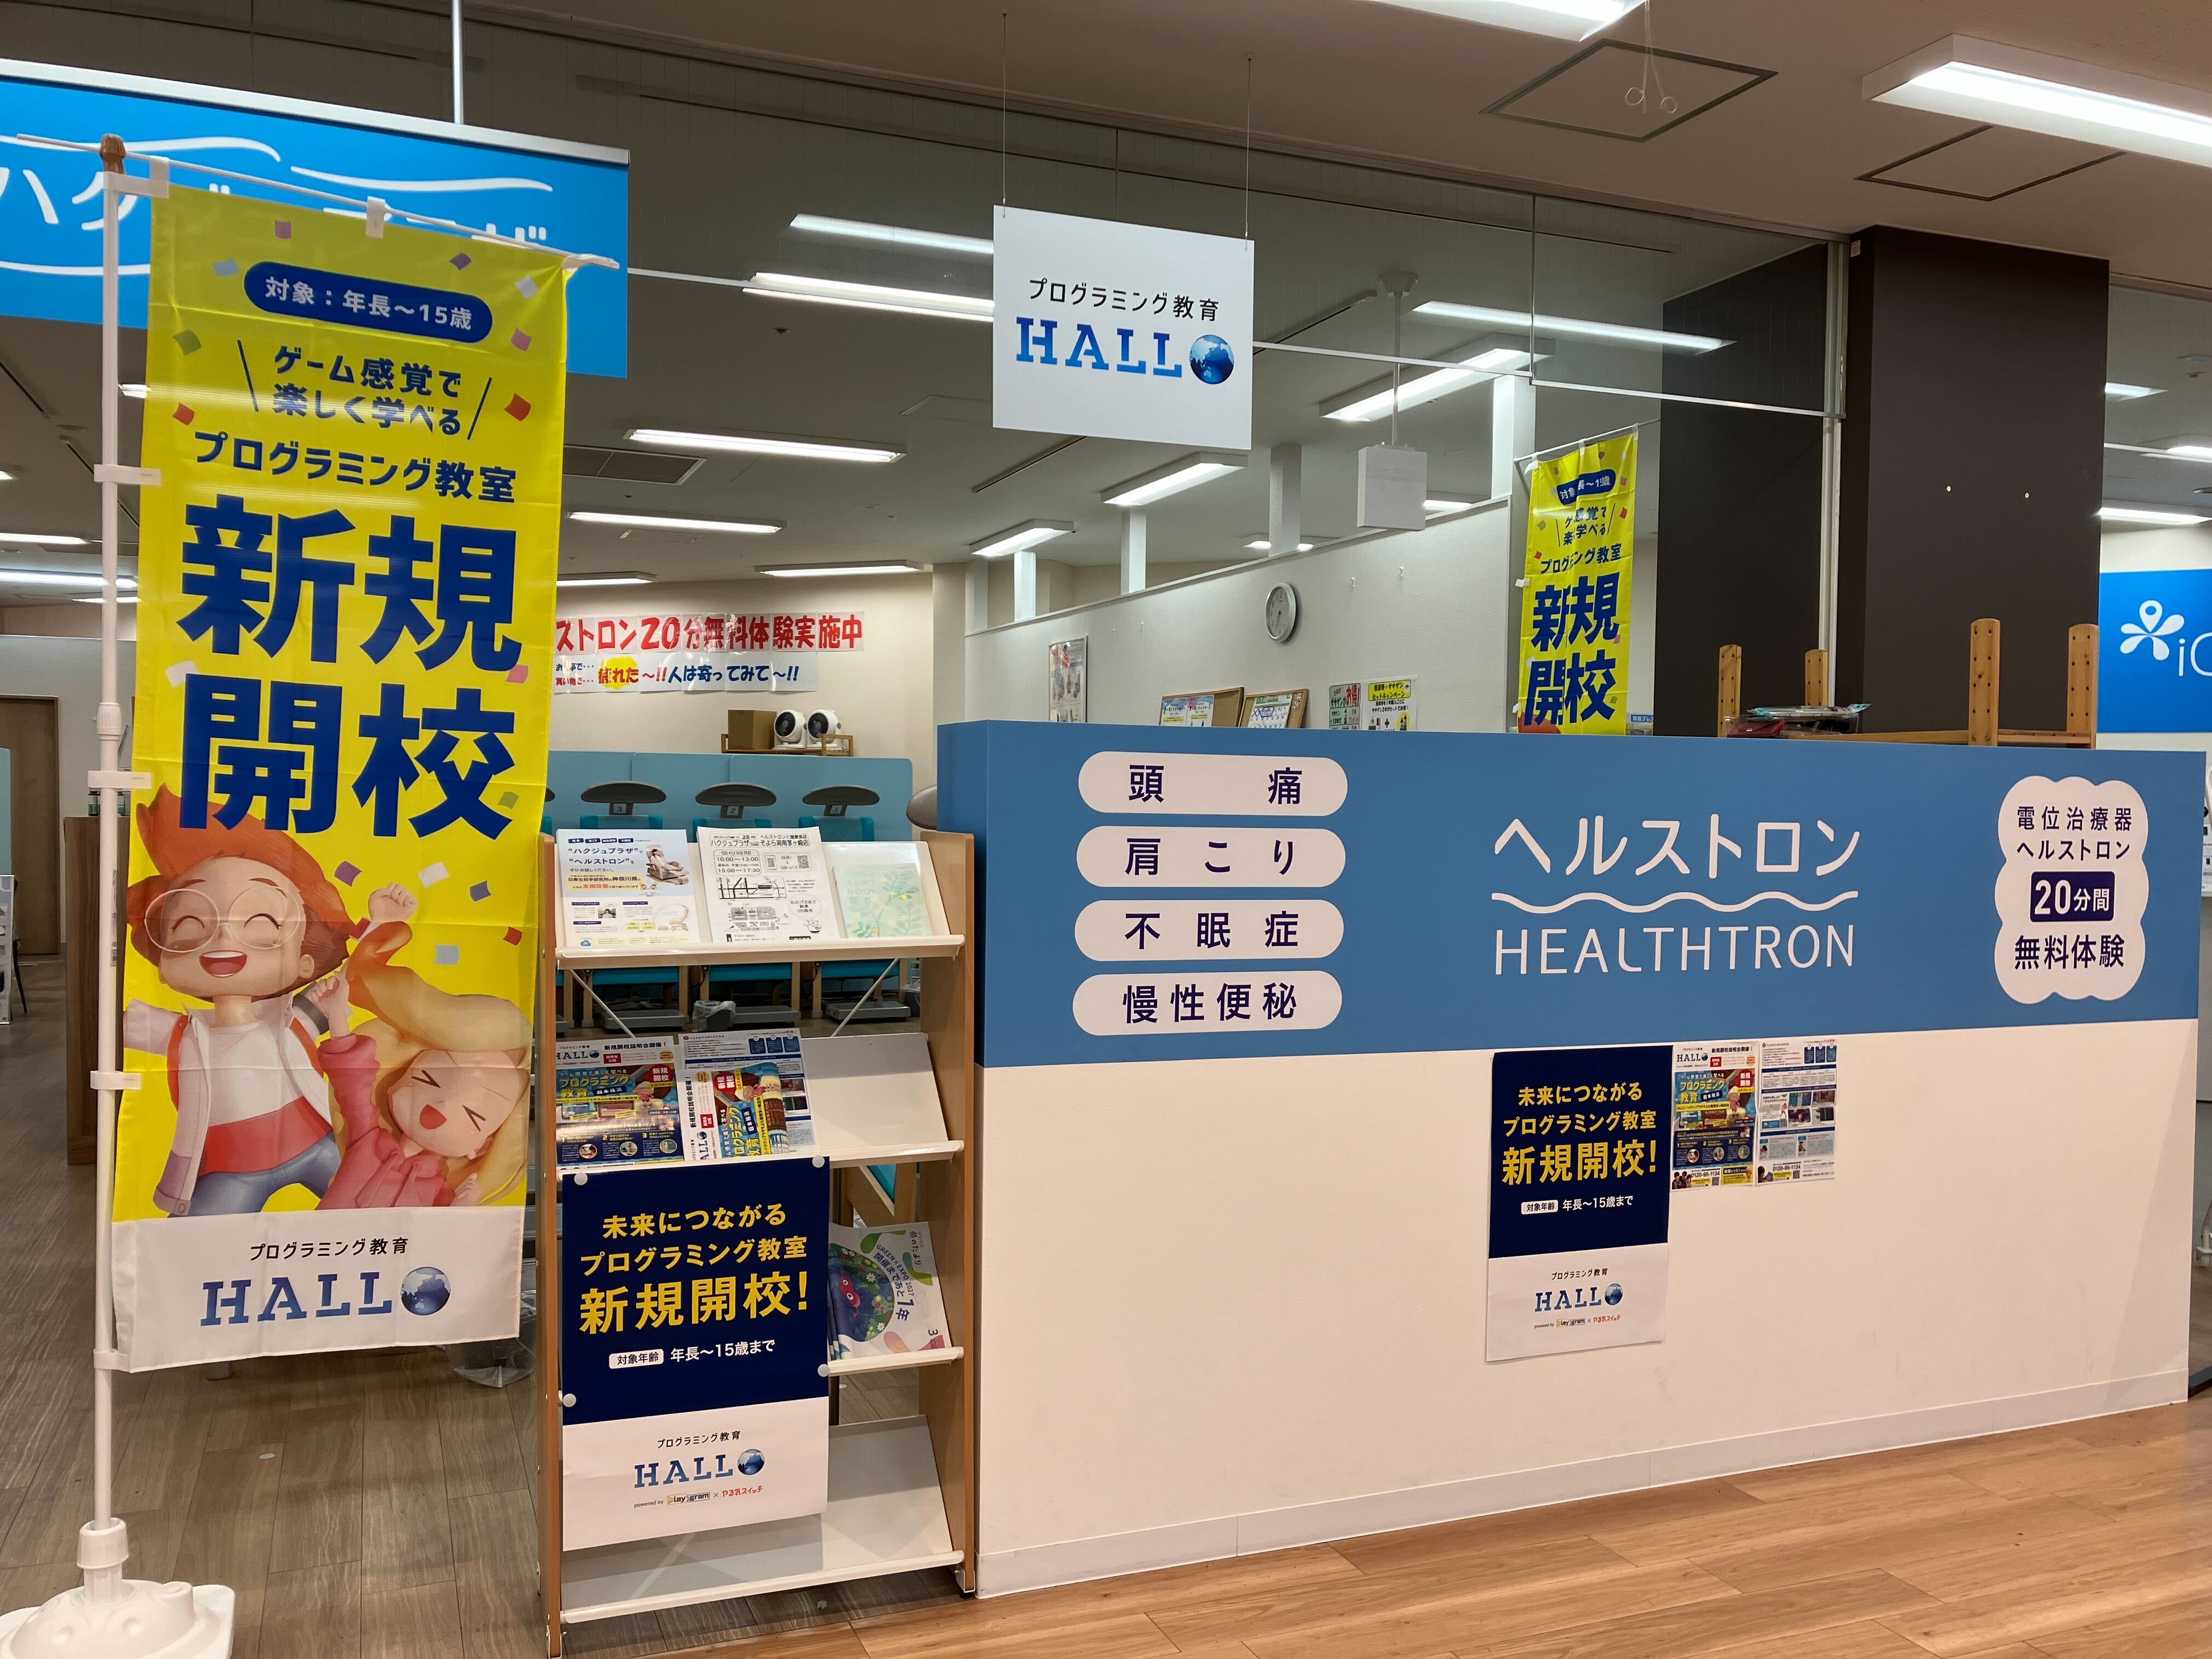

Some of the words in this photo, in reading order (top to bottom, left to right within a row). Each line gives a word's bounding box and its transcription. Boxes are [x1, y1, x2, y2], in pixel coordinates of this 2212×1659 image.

[1029, 278, 1219, 321] プログラミング教育
[274, 346, 462, 398] ゲーム感覚で
[273, 383, 462, 436] 楽しく学べる
[194, 431, 517, 503] プログラミング教室
[176, 493, 522, 671] 新規
[1531, 571, 1621, 652] 新規
[1523, 649, 1617, 726] 開校
[179, 673, 516, 840] 開校
[1128, 764, 1303, 805] 頭痛
[2017, 805, 2132, 831] 電位治療器
[1125, 838, 1294, 876] 肩こり
[1494, 813, 1860, 879] ヘルストロン
[2016, 839, 2130, 861] ヘルストロン
[2034, 879, 2111, 916] 20分間
[1124, 911, 1299, 950] 不眠症
[1495, 924, 1854, 975] HEALTHTRON
[2014, 933, 2125, 970] 無料体験
[1122, 981, 1297, 1024] 慢性便秘
[559, 1075, 630, 1088] プログラミング
[1518, 1081, 1643, 1107] 未来につながる
[1503, 1109, 1657, 1137] プログラミング教室
[1502, 1139, 1656, 1186] 新規開校!
[602, 1203, 786, 1239] 未来につながる
[1526, 1202, 1555, 1212] 対象年齢
[250, 1237, 409, 1261] プログラミング教育
[580, 1235, 808, 1277] プログラミング教室
[905, 1281, 915, 1296] 2027
[1551, 1268, 1609, 1280] プログラミング教育
[579, 1271, 808, 1335] 新規開校!
[617, 1352, 659, 1365] 対象年齢
[657, 1430, 741, 1449] プログラミング教育
[634, 1500, 657, 1509] powered
[721, 1485, 764, 1498] やる気スイッチ
